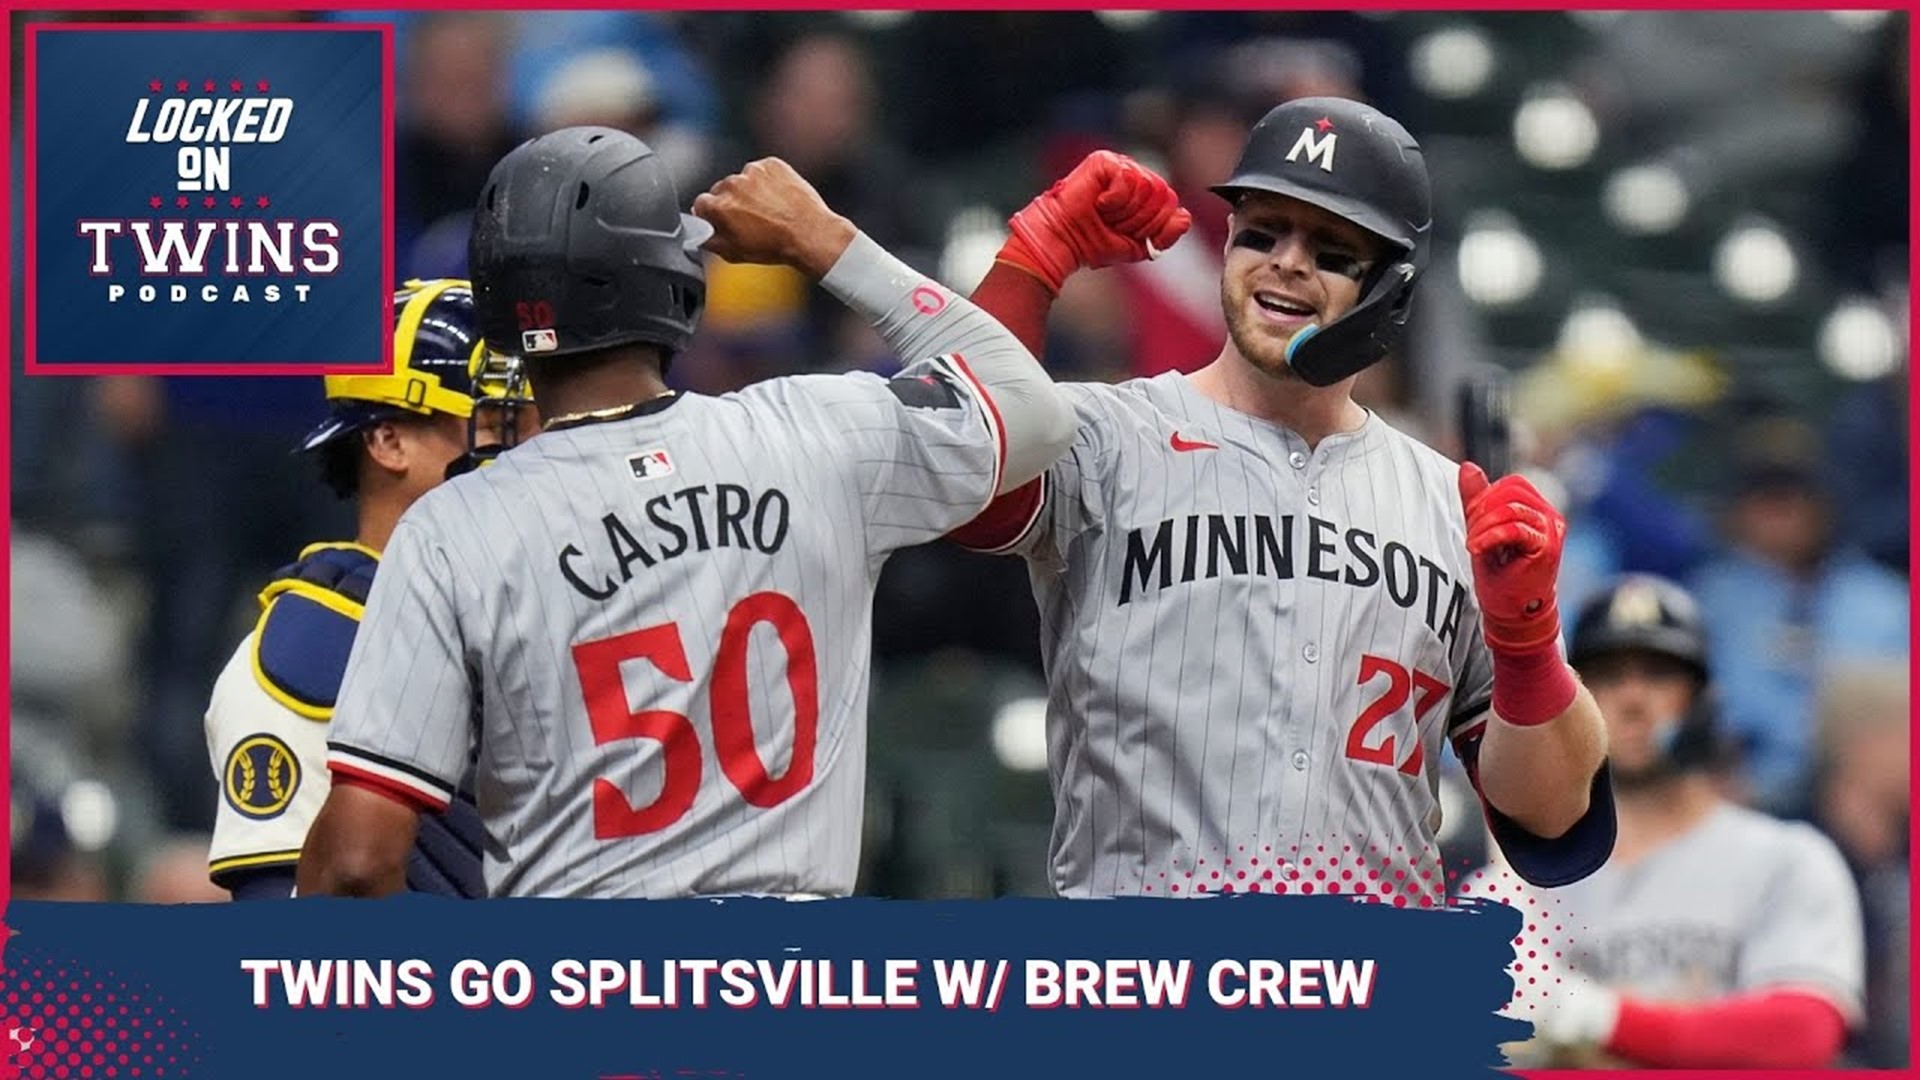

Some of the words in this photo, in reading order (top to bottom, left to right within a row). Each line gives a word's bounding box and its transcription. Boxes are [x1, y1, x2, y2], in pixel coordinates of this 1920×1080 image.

[1285, 127, 1338, 173] M
[558, 484, 790, 601] CASTRO
[1118, 514, 1466, 662] MINNESOTA
[571, 591, 818, 840] 50
[1345, 653, 1451, 777] 27
